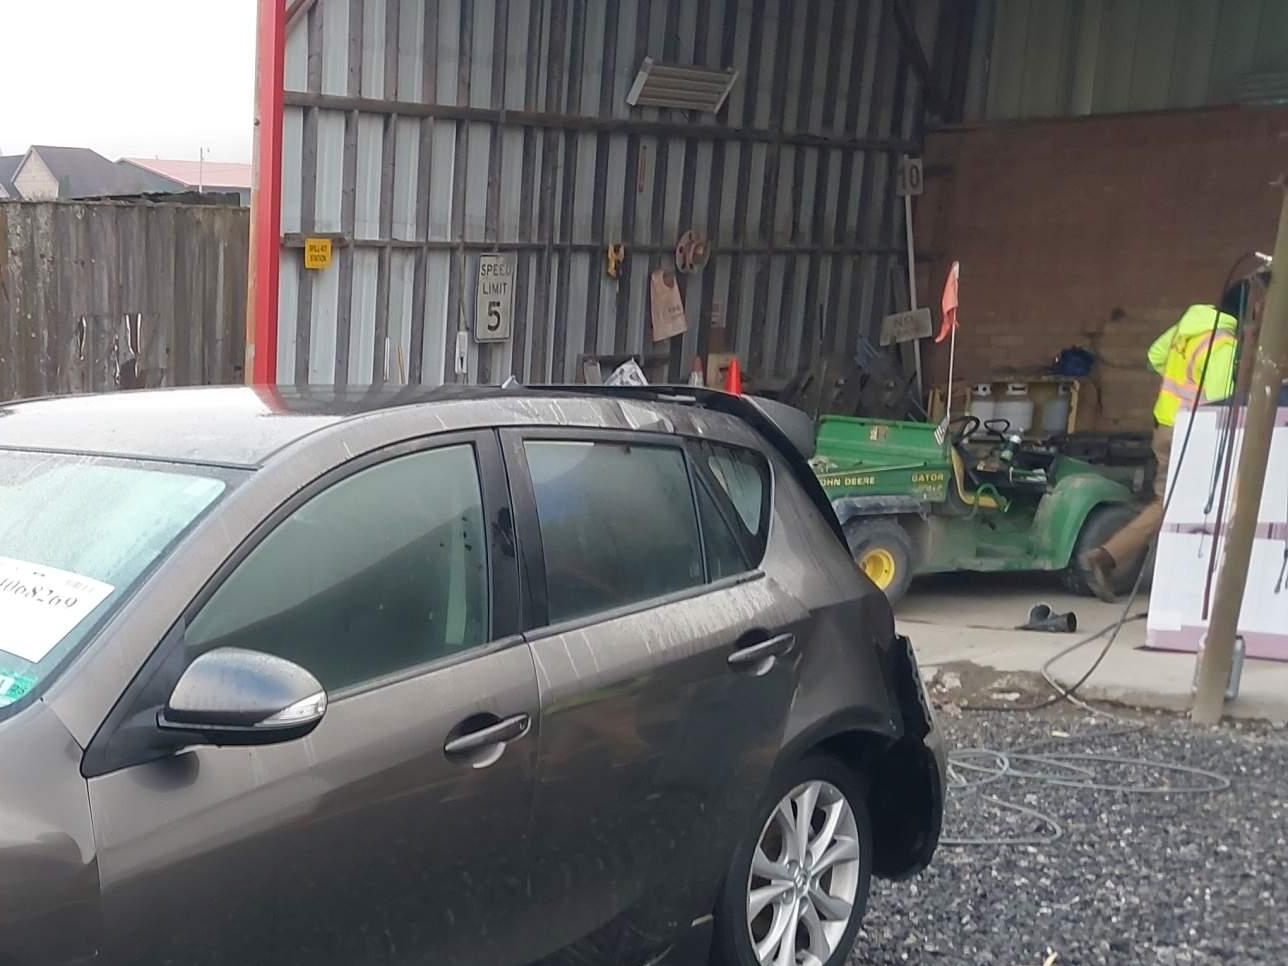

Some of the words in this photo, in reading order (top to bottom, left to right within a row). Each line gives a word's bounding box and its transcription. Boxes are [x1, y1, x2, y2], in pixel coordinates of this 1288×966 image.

[480, 263, 512, 276] SPEED
[482, 282, 507, 295] LIMIT
[487, 301, 500, 331] 5
[844, 476, 875, 486] DEERE
[911, 471, 944, 482] GATOR
